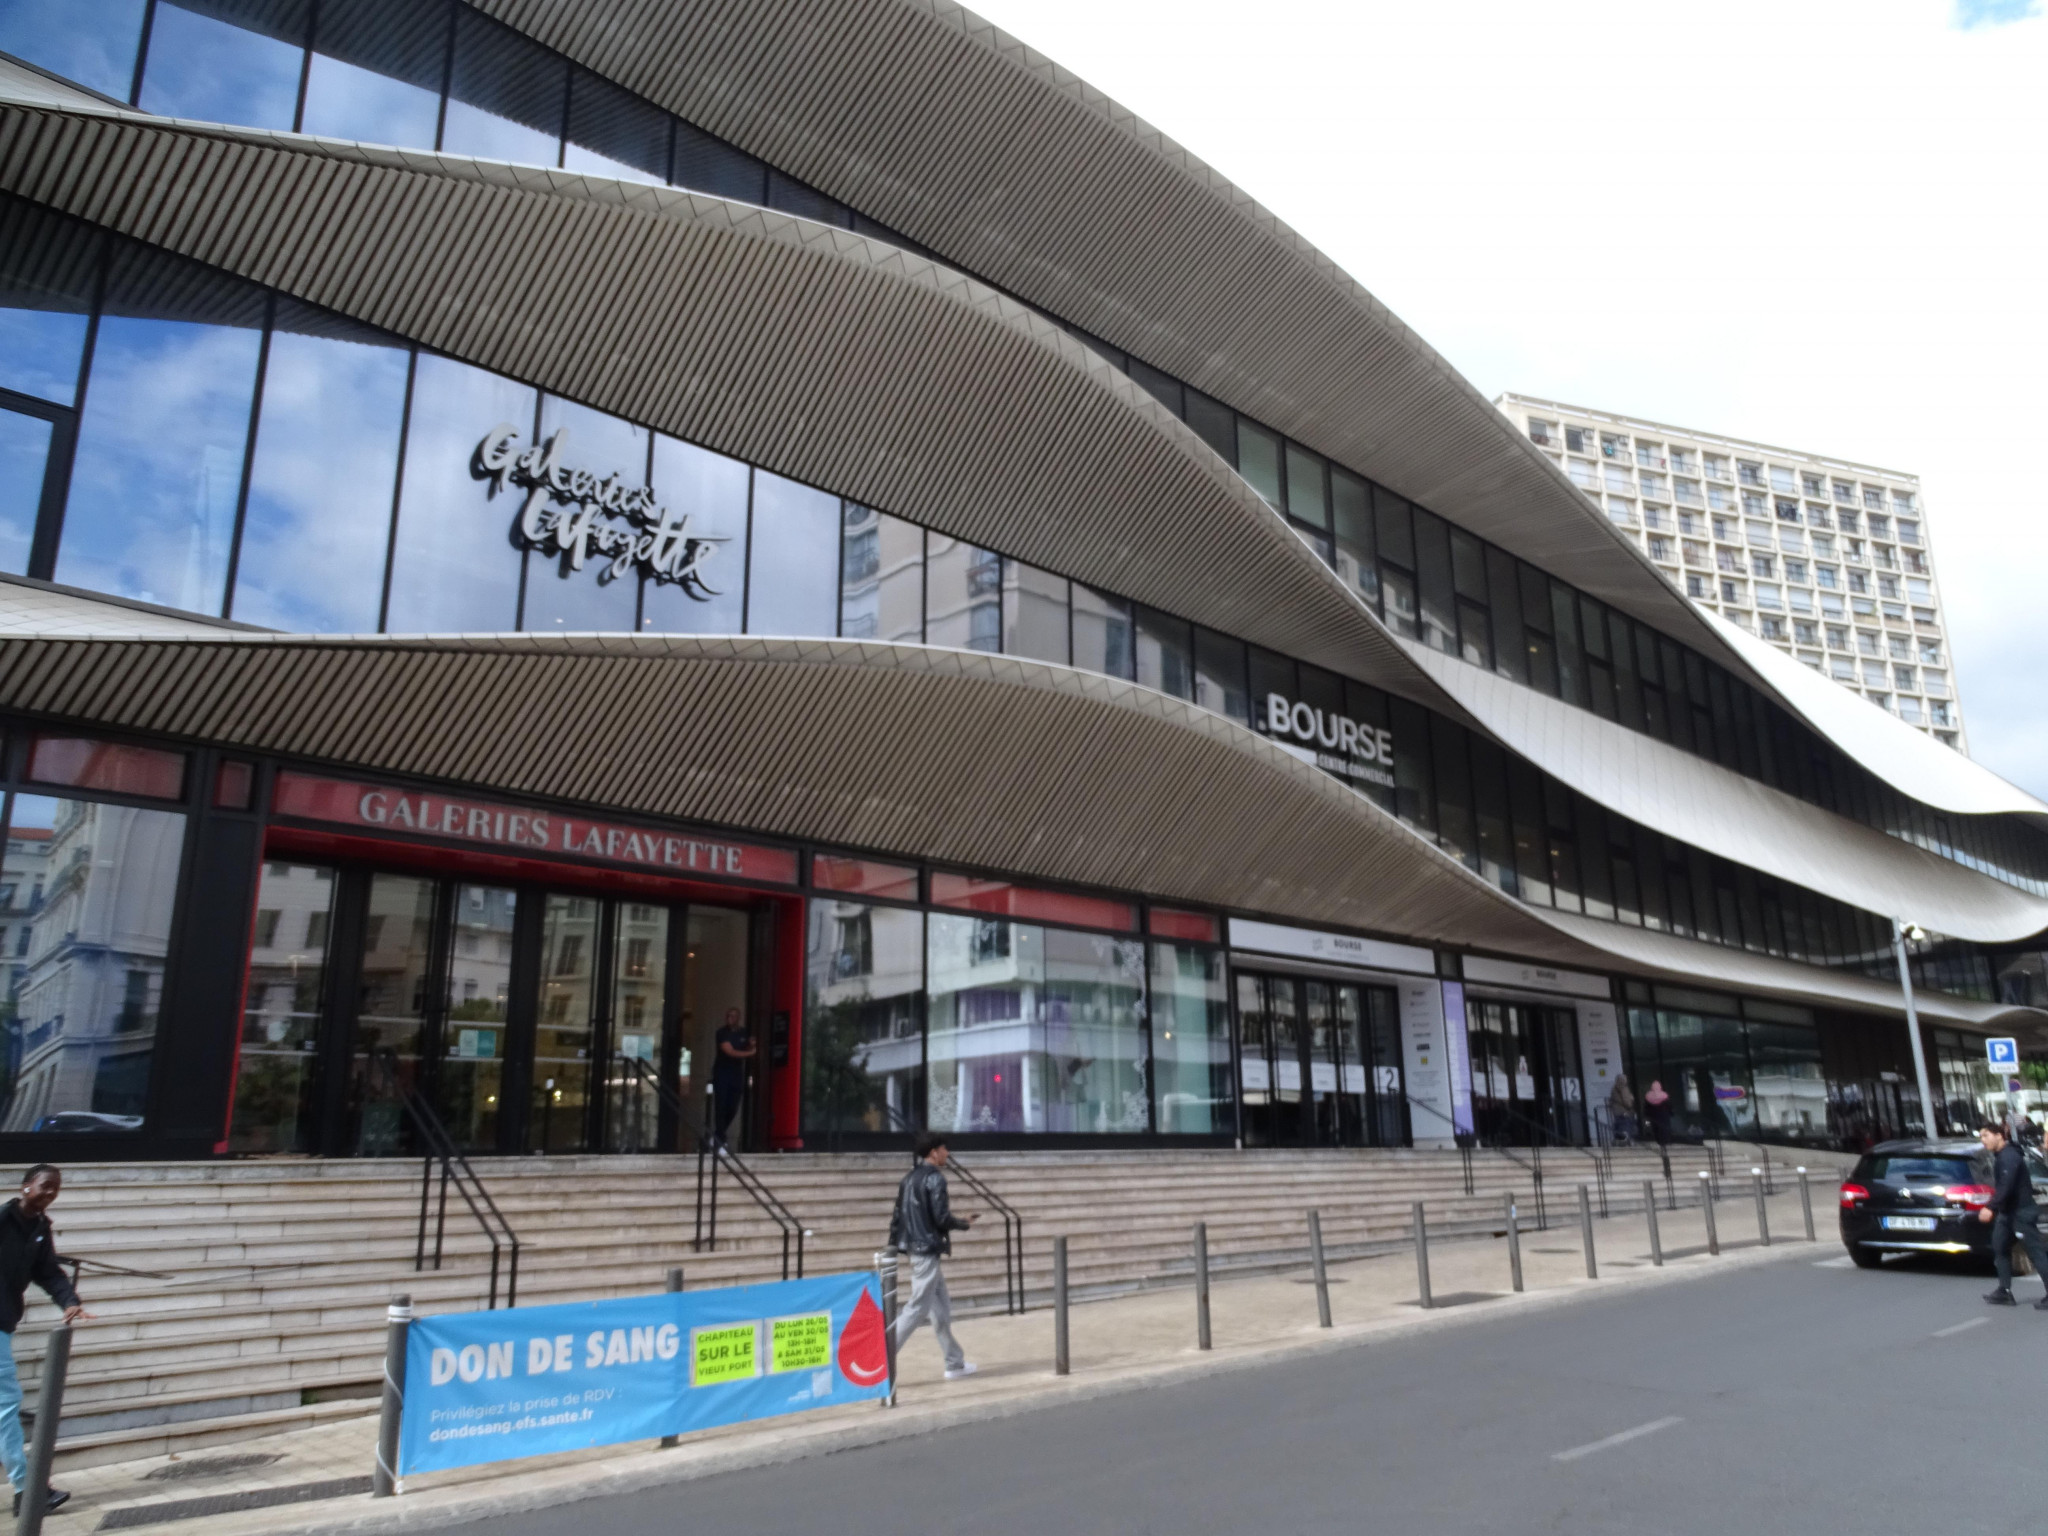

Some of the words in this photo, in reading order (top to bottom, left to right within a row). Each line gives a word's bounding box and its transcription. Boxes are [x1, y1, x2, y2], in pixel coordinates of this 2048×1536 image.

[481, 422, 656, 519] Galeries
[522, 487, 732, 595] Lafayette
[1267, 692, 1394, 766] BOURSE
[360, 792, 549, 847] GALERIES
[562, 822, 743, 874] LAFAYETTE
[1334, 938, 1362, 952] BOURSE
[1994, 1043, 2009, 1061] P
[774, 1320, 786, 1330] DU
[788, 1319, 804, 1328] LUN
[698, 1327, 754, 1343] CHAPITEAU
[774, 1330, 786, 1340] AU
[788, 1329, 804, 1337] VEN
[430, 1341, 515, 1387] DON
[527, 1334, 574, 1377] DE
[585, 1323, 680, 1369] SANG
[699, 1345, 730, 1361] SUR
[734, 1342, 752, 1356] LE
[785, 1348, 802, 1357] SAM
[698, 1365, 726, 1376] VIEUX
[728, 1360, 752, 1372] PORT
[431, 1402, 505, 1423] Privilégiez
[509, 1399, 521, 1413] la
[525, 1395, 559, 1414] prise
[563, 1391, 581, 1406] de
[584, 1388, 616, 1403] RDV
[429, 1408, 595, 1443] dondesang.efs.sante.fr
